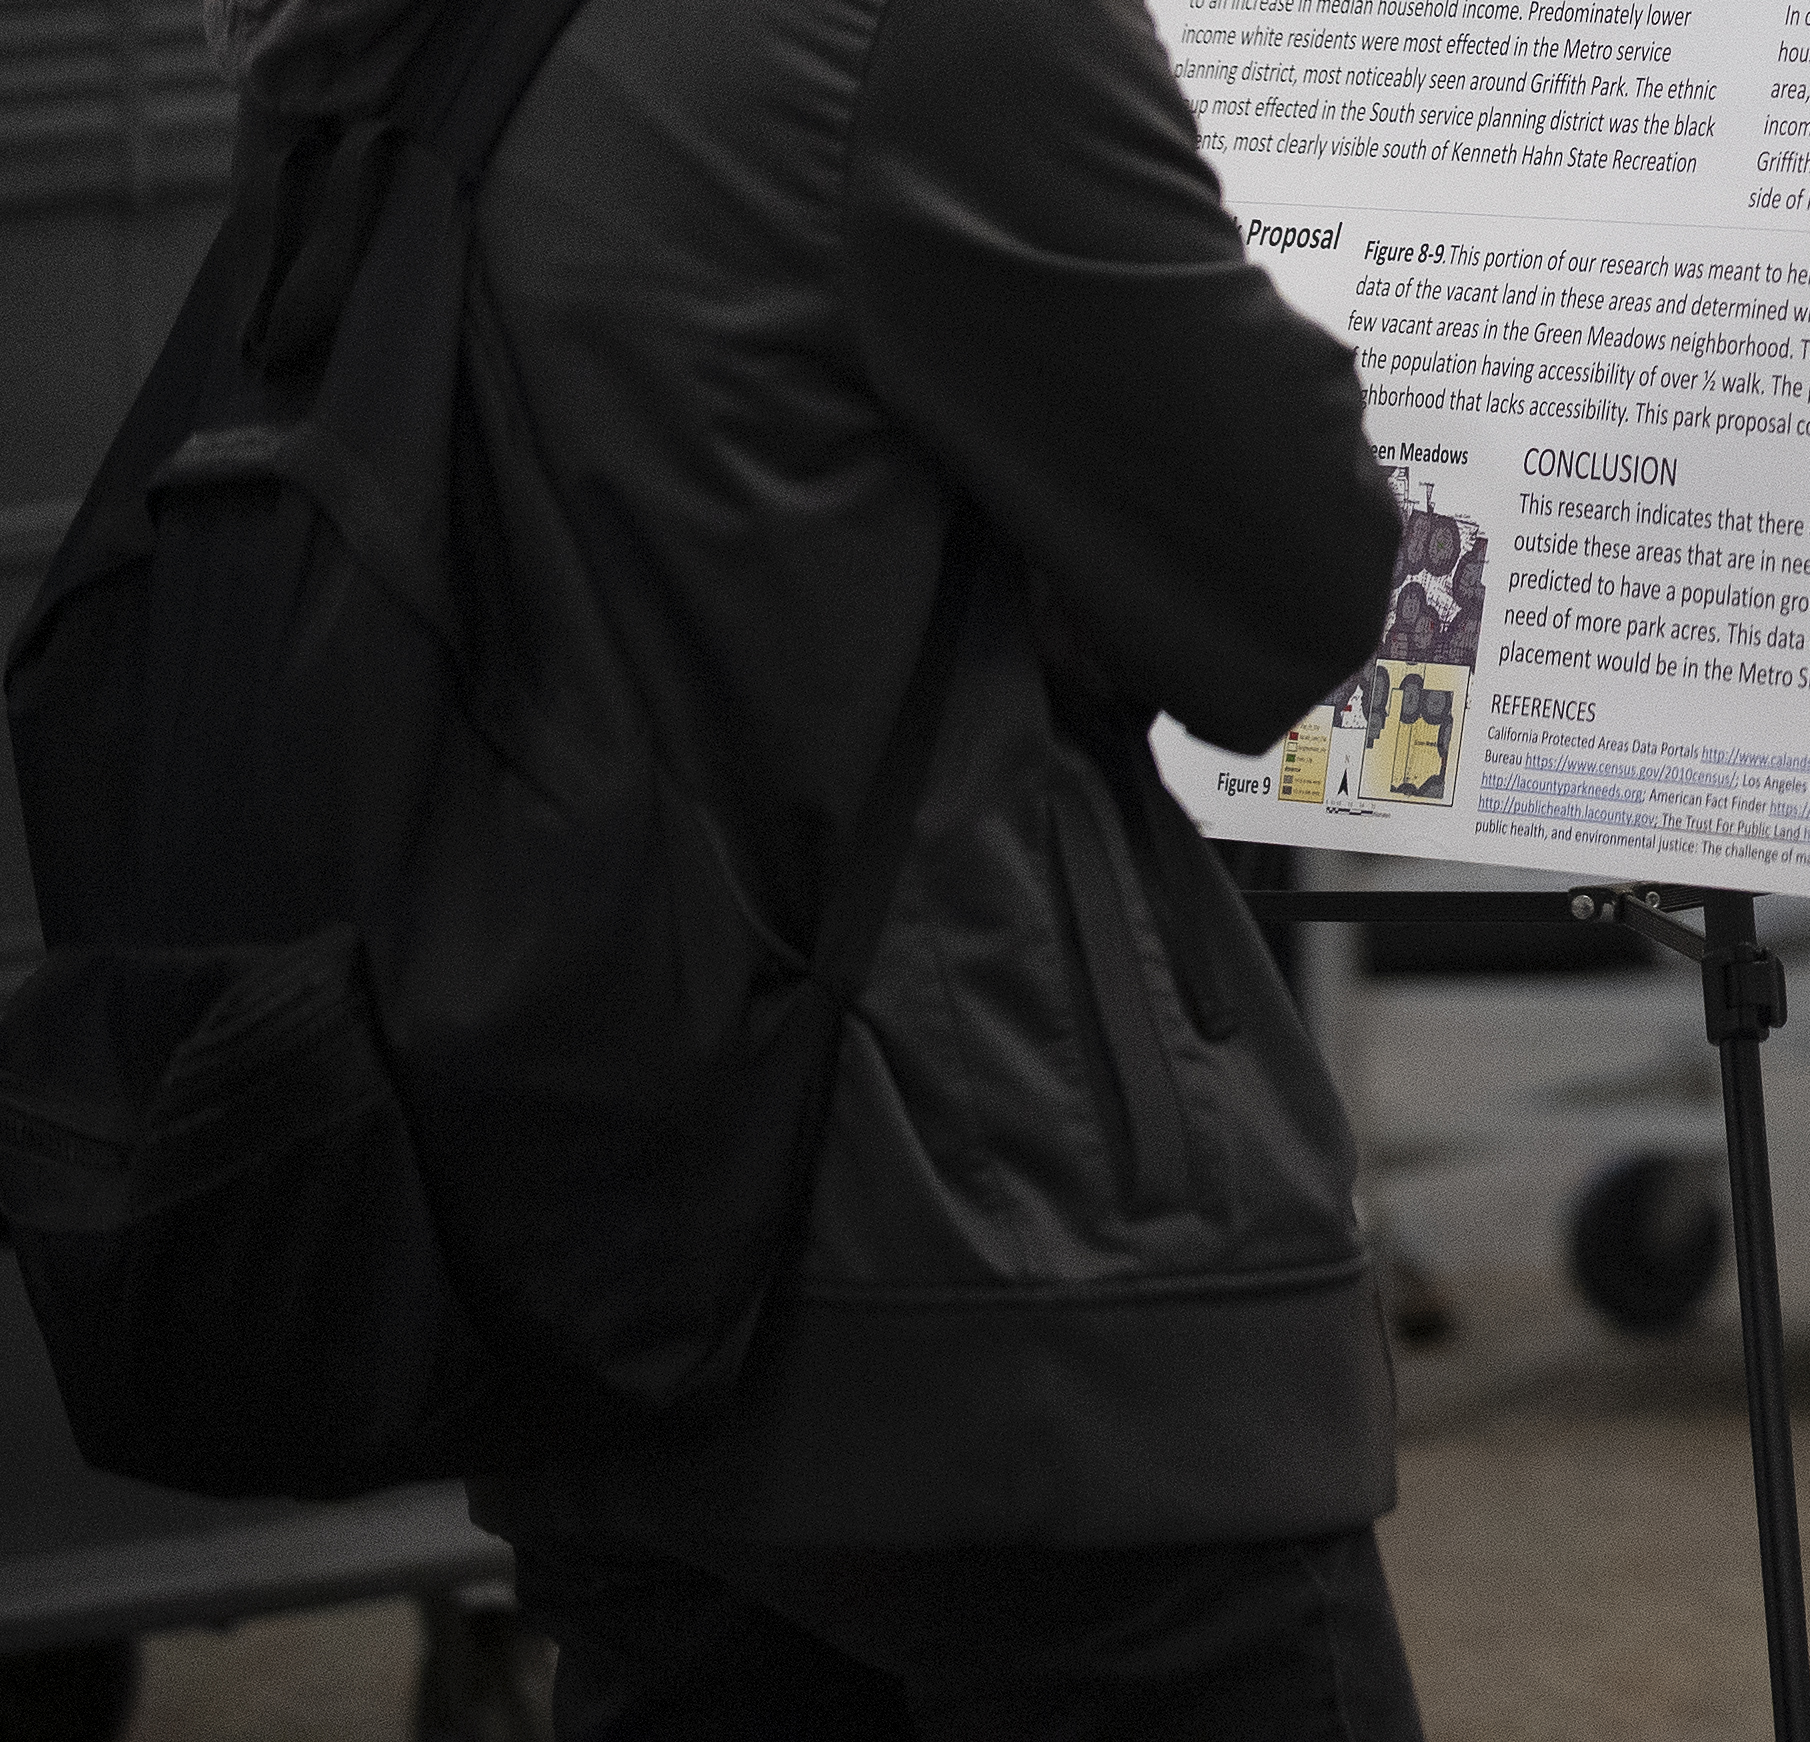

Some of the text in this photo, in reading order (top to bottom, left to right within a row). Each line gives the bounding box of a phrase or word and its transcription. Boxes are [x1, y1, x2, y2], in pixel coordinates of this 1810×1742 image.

[1246, 218, 1343, 254] Proposal
[1400, 442, 1468, 465] Meadows
[1523, 447, 1678, 487] CONCLUSION
[1498, 640, 1592, 670] placement
[1596, 651, 1652, 675] would
[1655, 652, 1678, 677] be
[1682, 655, 1699, 679] in
[1704, 658, 1734, 683] the
[1738, 661, 1793, 688] Metro
[1491, 693, 1596, 723] REFERENCES
[1217, 772, 1272, 798] Figure 9
